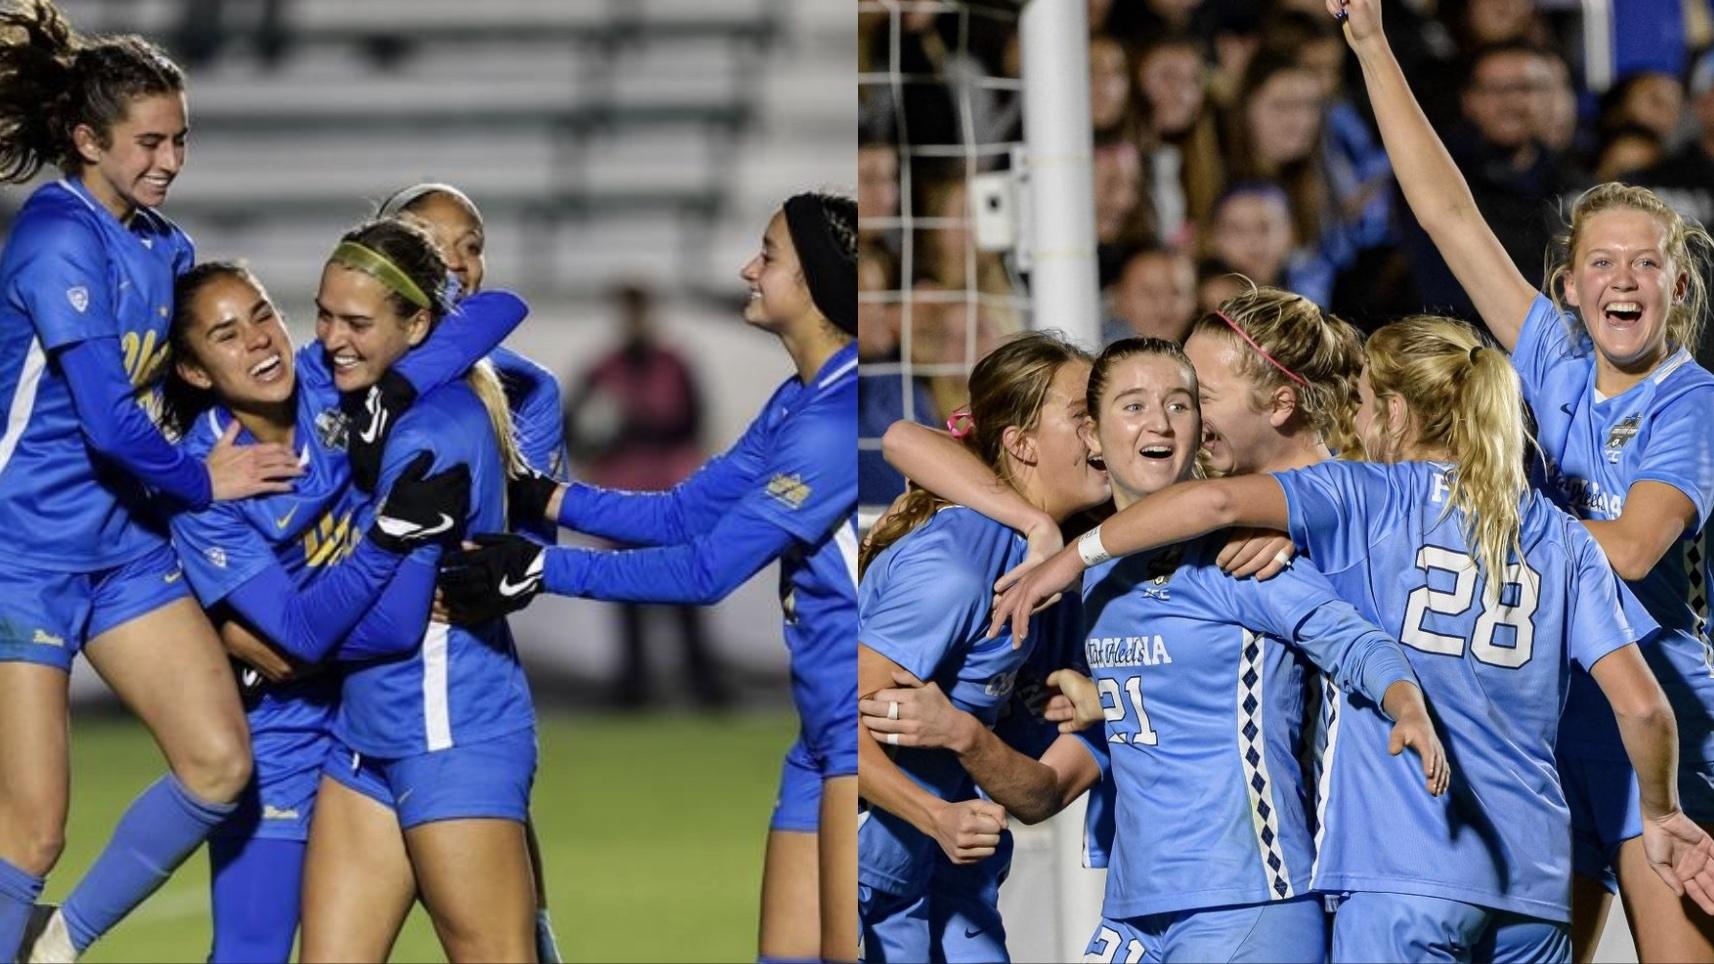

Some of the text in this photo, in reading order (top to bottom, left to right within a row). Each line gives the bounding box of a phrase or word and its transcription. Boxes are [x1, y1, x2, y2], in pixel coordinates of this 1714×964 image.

[1399, 543, 1542, 670] 28
[1105, 637, 1145, 664] Heels
[1097, 675, 1158, 746] 21
